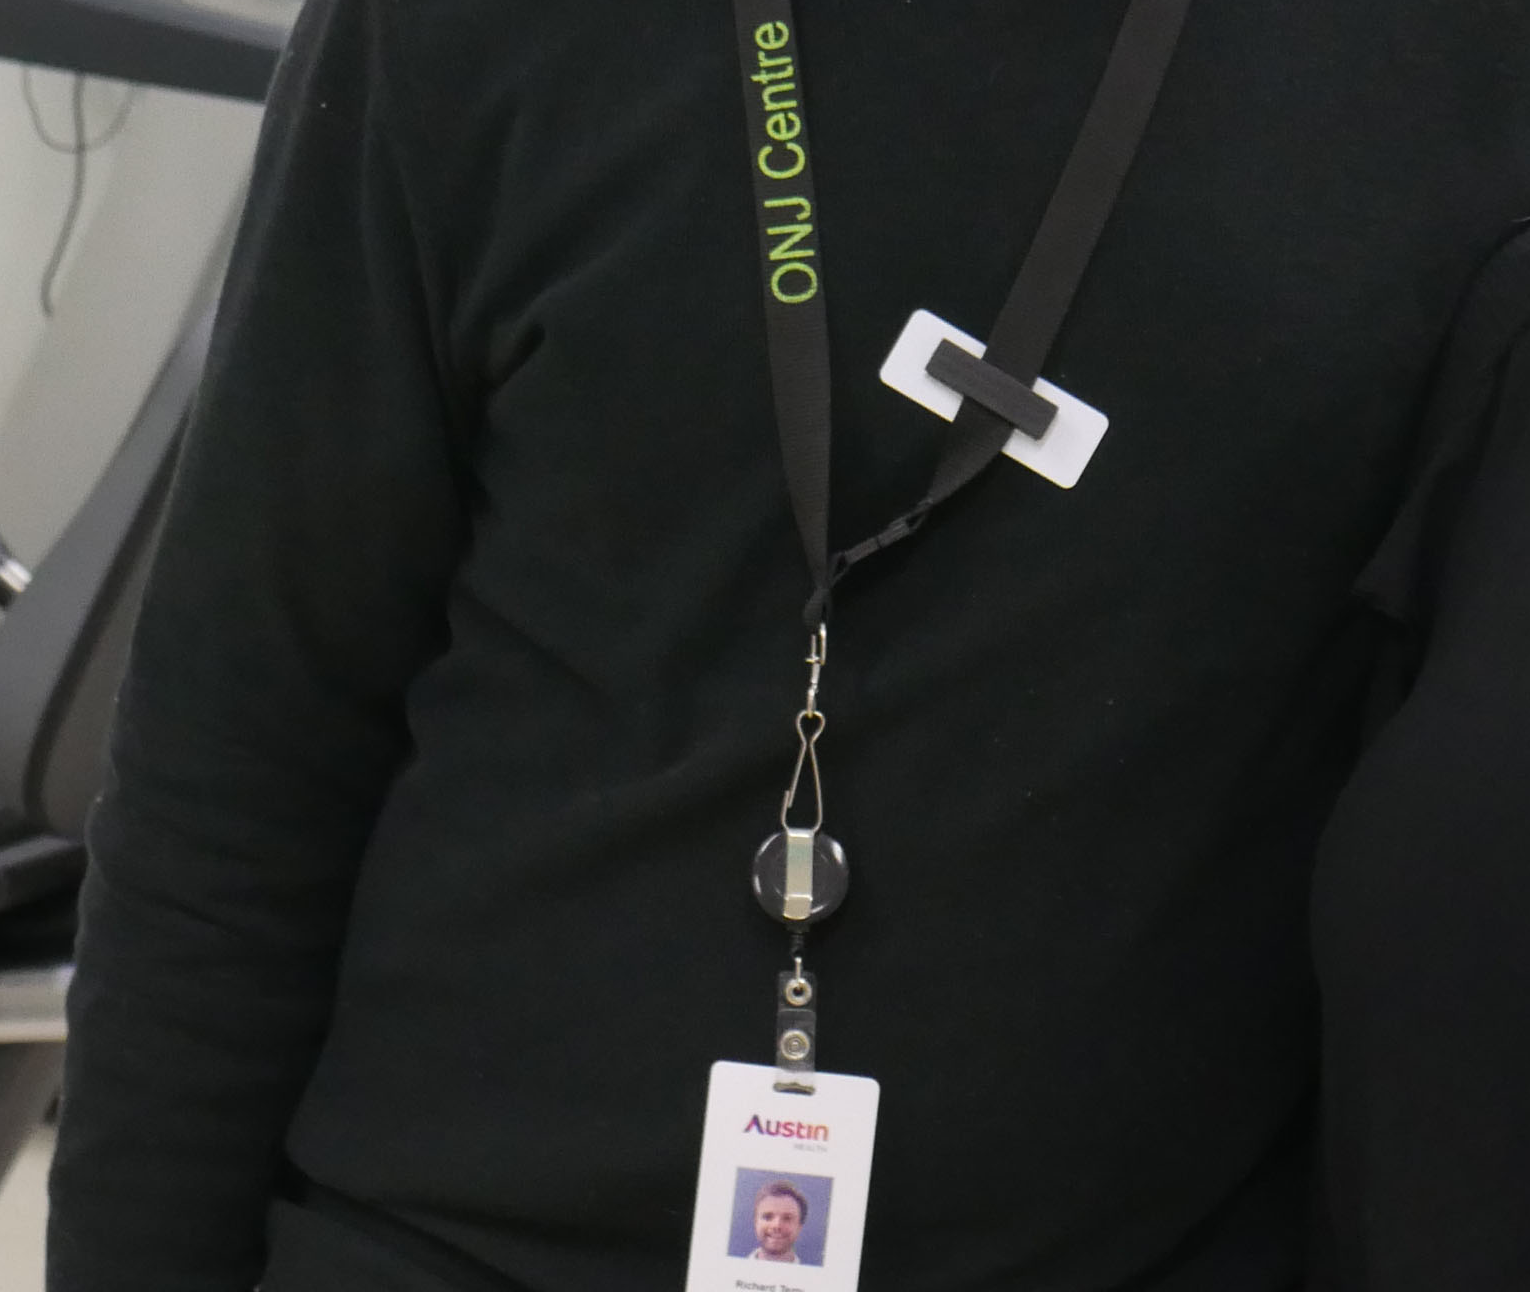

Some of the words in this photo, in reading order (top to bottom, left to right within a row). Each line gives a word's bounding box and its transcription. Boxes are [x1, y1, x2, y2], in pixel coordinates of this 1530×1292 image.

[750, 19, 807, 180] Centre
[763, 196, 818, 306] ONJ
[743, 1114, 829, 1142] Austin
